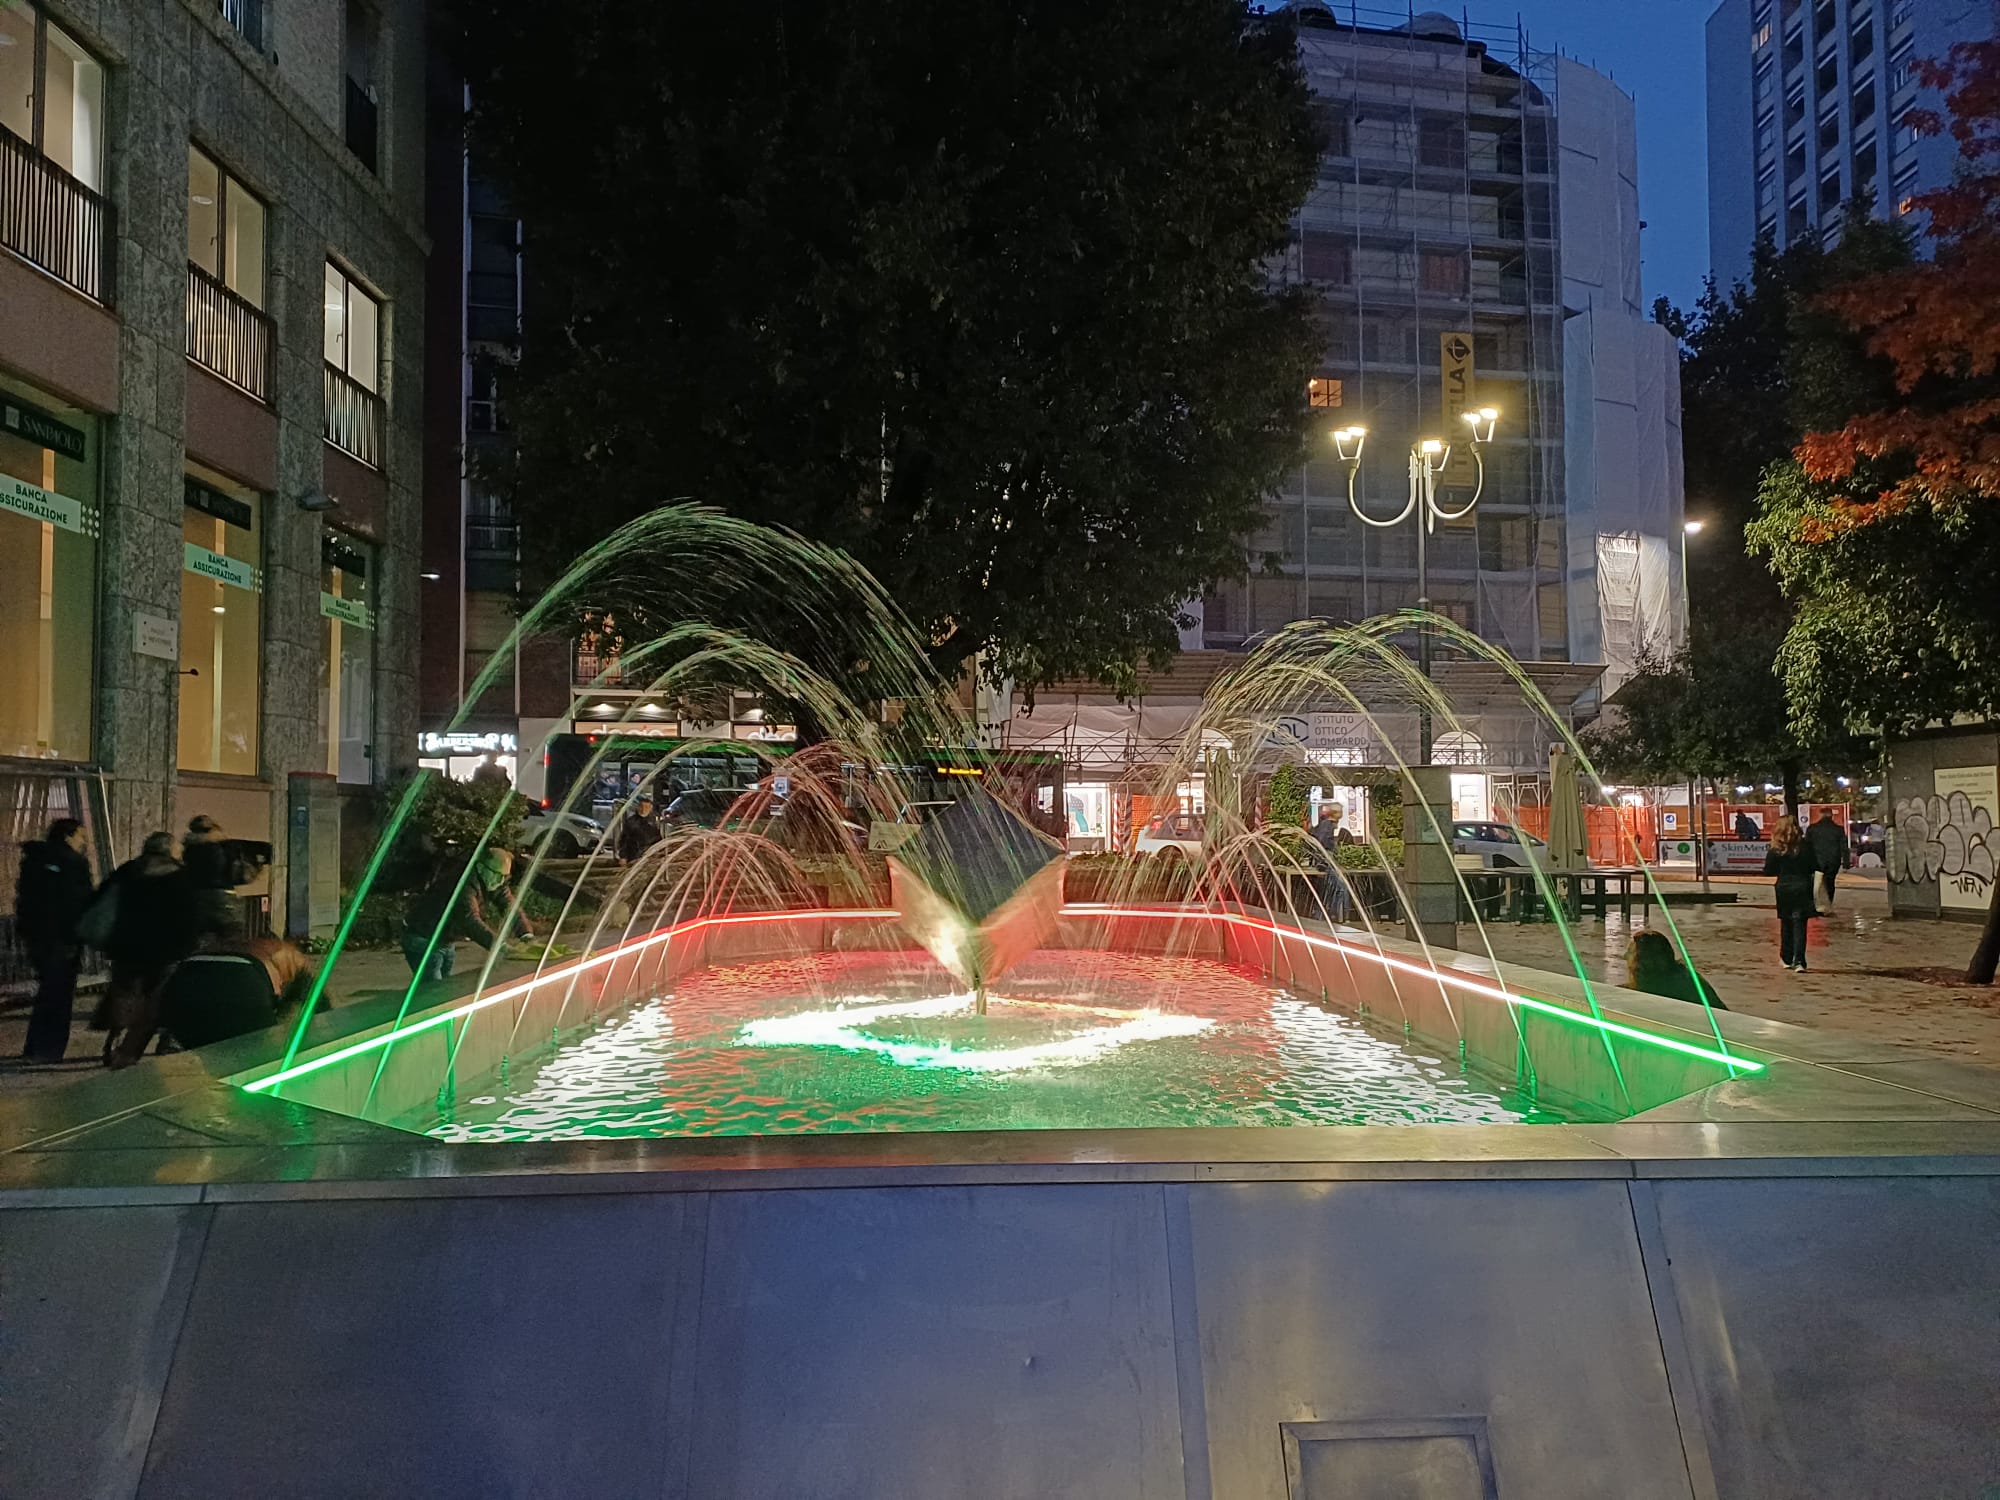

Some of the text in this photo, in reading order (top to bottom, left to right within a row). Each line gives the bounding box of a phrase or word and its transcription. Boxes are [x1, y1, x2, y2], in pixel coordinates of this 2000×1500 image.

[15, 483, 48, 504] BANCA
[0, 492, 68, 524] SSICURAZIONE
[208, 553, 229, 569] BANCA
[193, 560, 242, 584] ASSICURAZIONE
[1314, 715, 1354, 724] ISTITUTO
[1314, 726, 1348, 735] OTTICO
[1315, 737, 1367, 746] LOMBARDO
